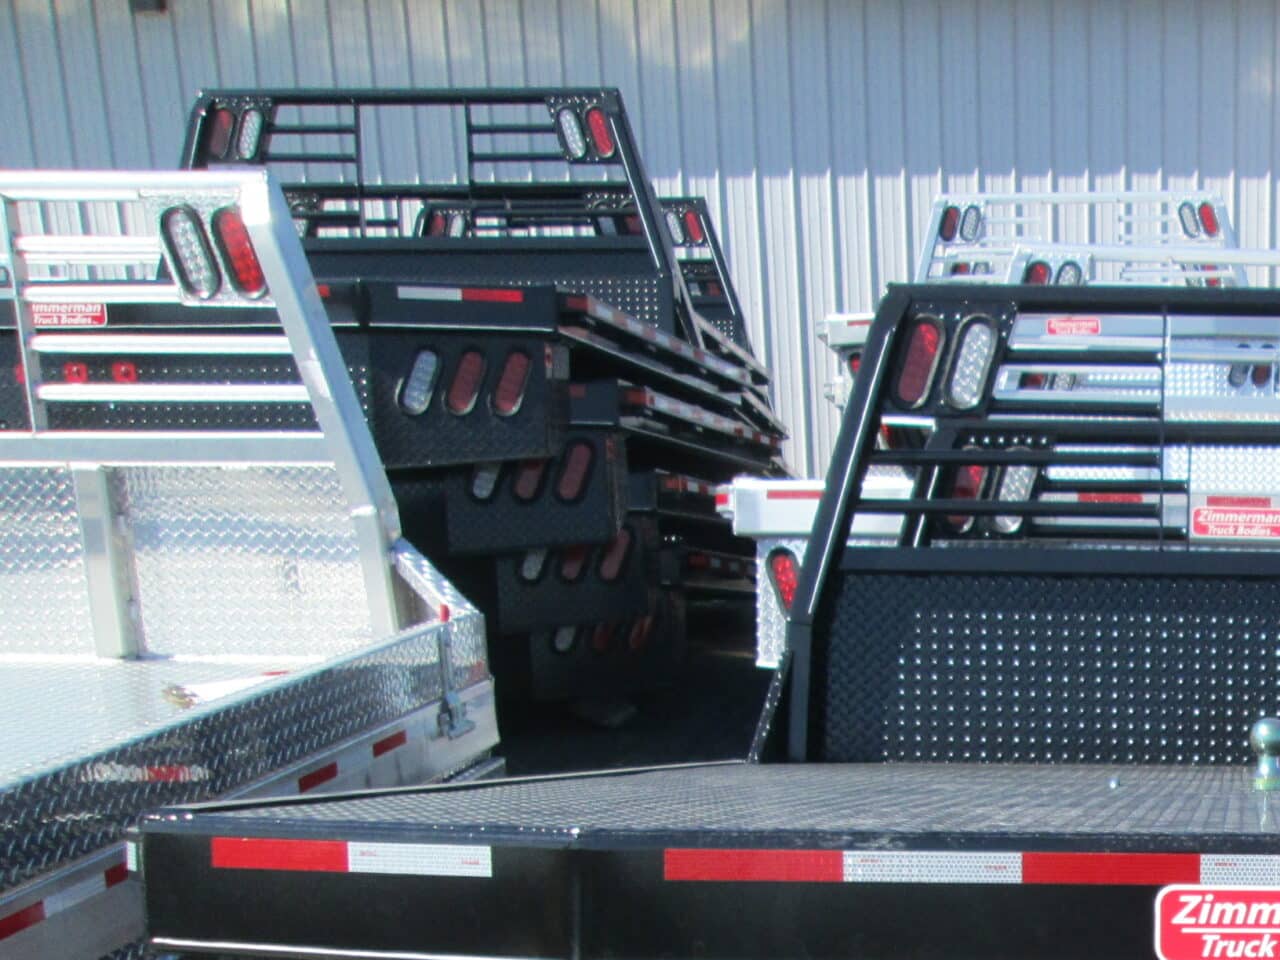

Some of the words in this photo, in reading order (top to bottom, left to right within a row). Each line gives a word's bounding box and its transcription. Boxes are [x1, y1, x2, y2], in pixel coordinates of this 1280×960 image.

[32, 303, 102, 313] immerman
[1208, 525, 1235, 536] Truck
[1236, 525, 1271, 537] Bodies
[1201, 934, 1278, 958] Truck
